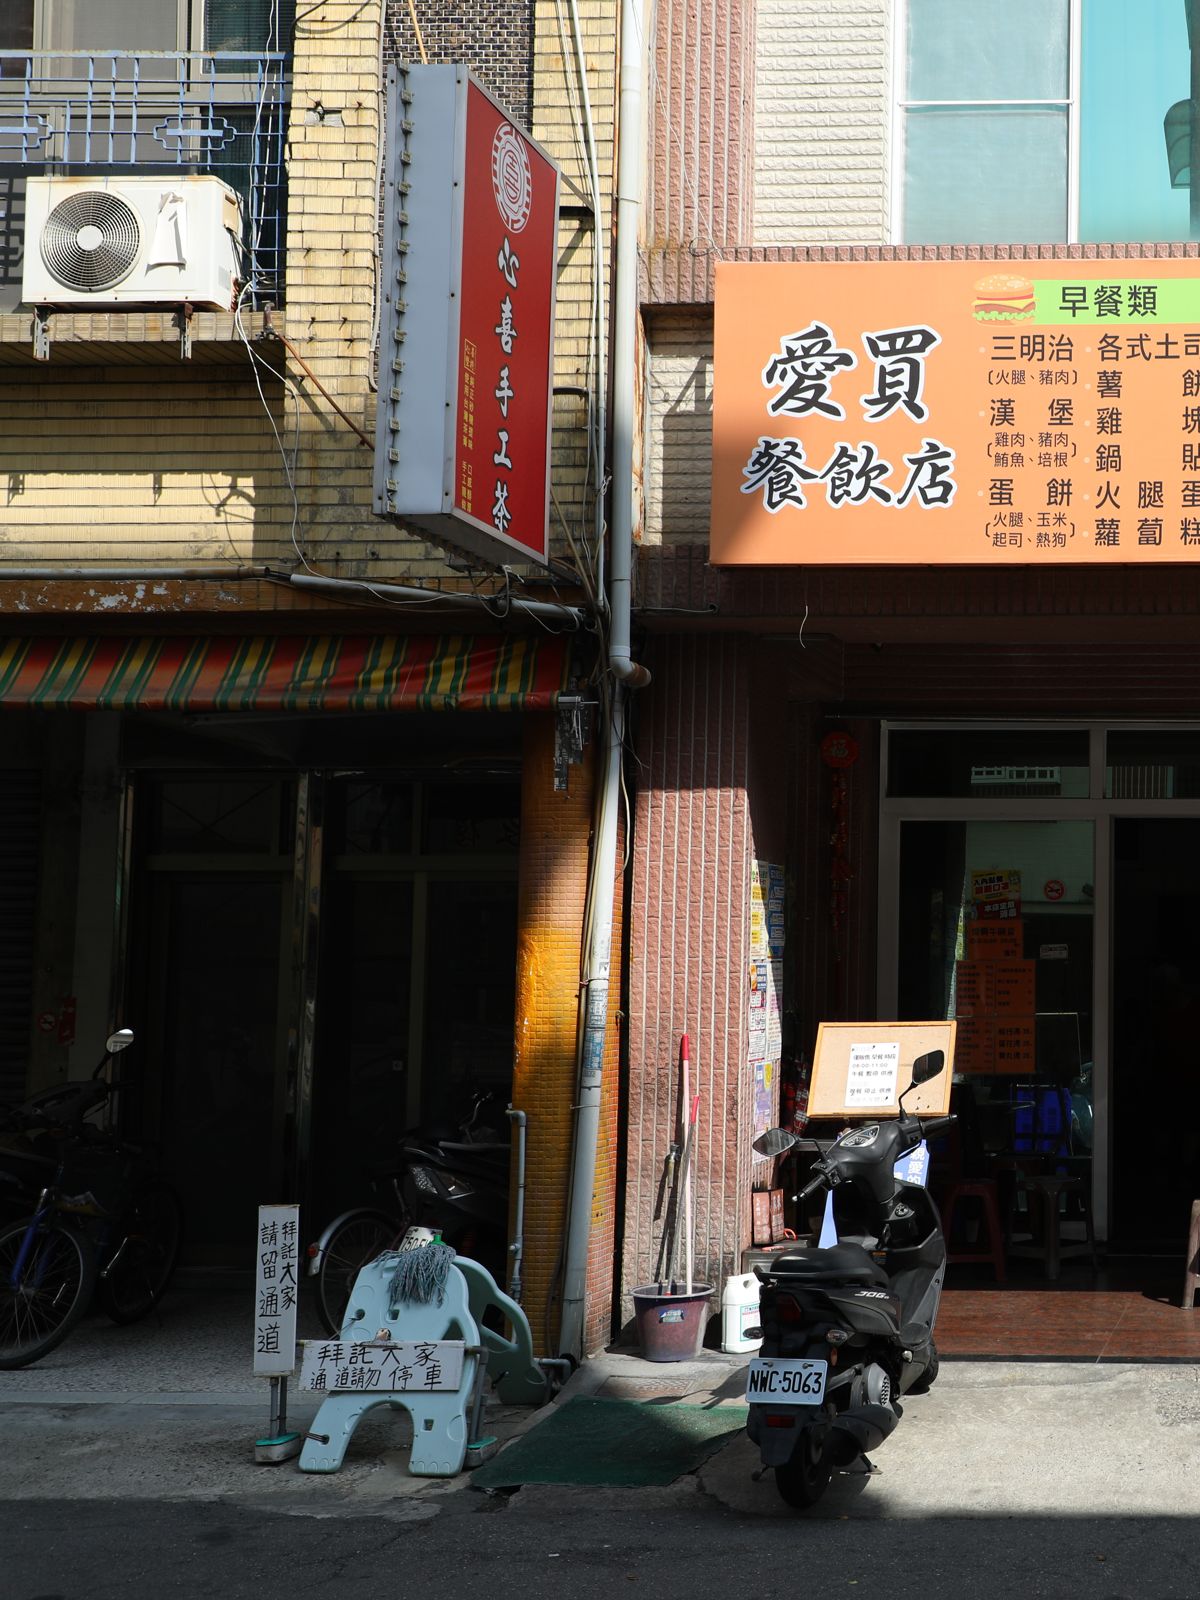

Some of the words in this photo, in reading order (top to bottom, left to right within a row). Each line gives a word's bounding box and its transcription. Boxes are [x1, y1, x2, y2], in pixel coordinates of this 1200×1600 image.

[1058, 284, 1158, 318] 早餐類
[765, 324, 938, 420] 愛買
[990, 333, 1074, 363] 三明治
[743, 438, 955, 511] 餐飲店
[257, 1221, 281, 1354] 請留通道
[281, 1221, 298, 1310] 拜託大家
[311, 1364, 442, 1390] 通道請勿停車
[317, 1342, 440, 1366] 拜託大家
